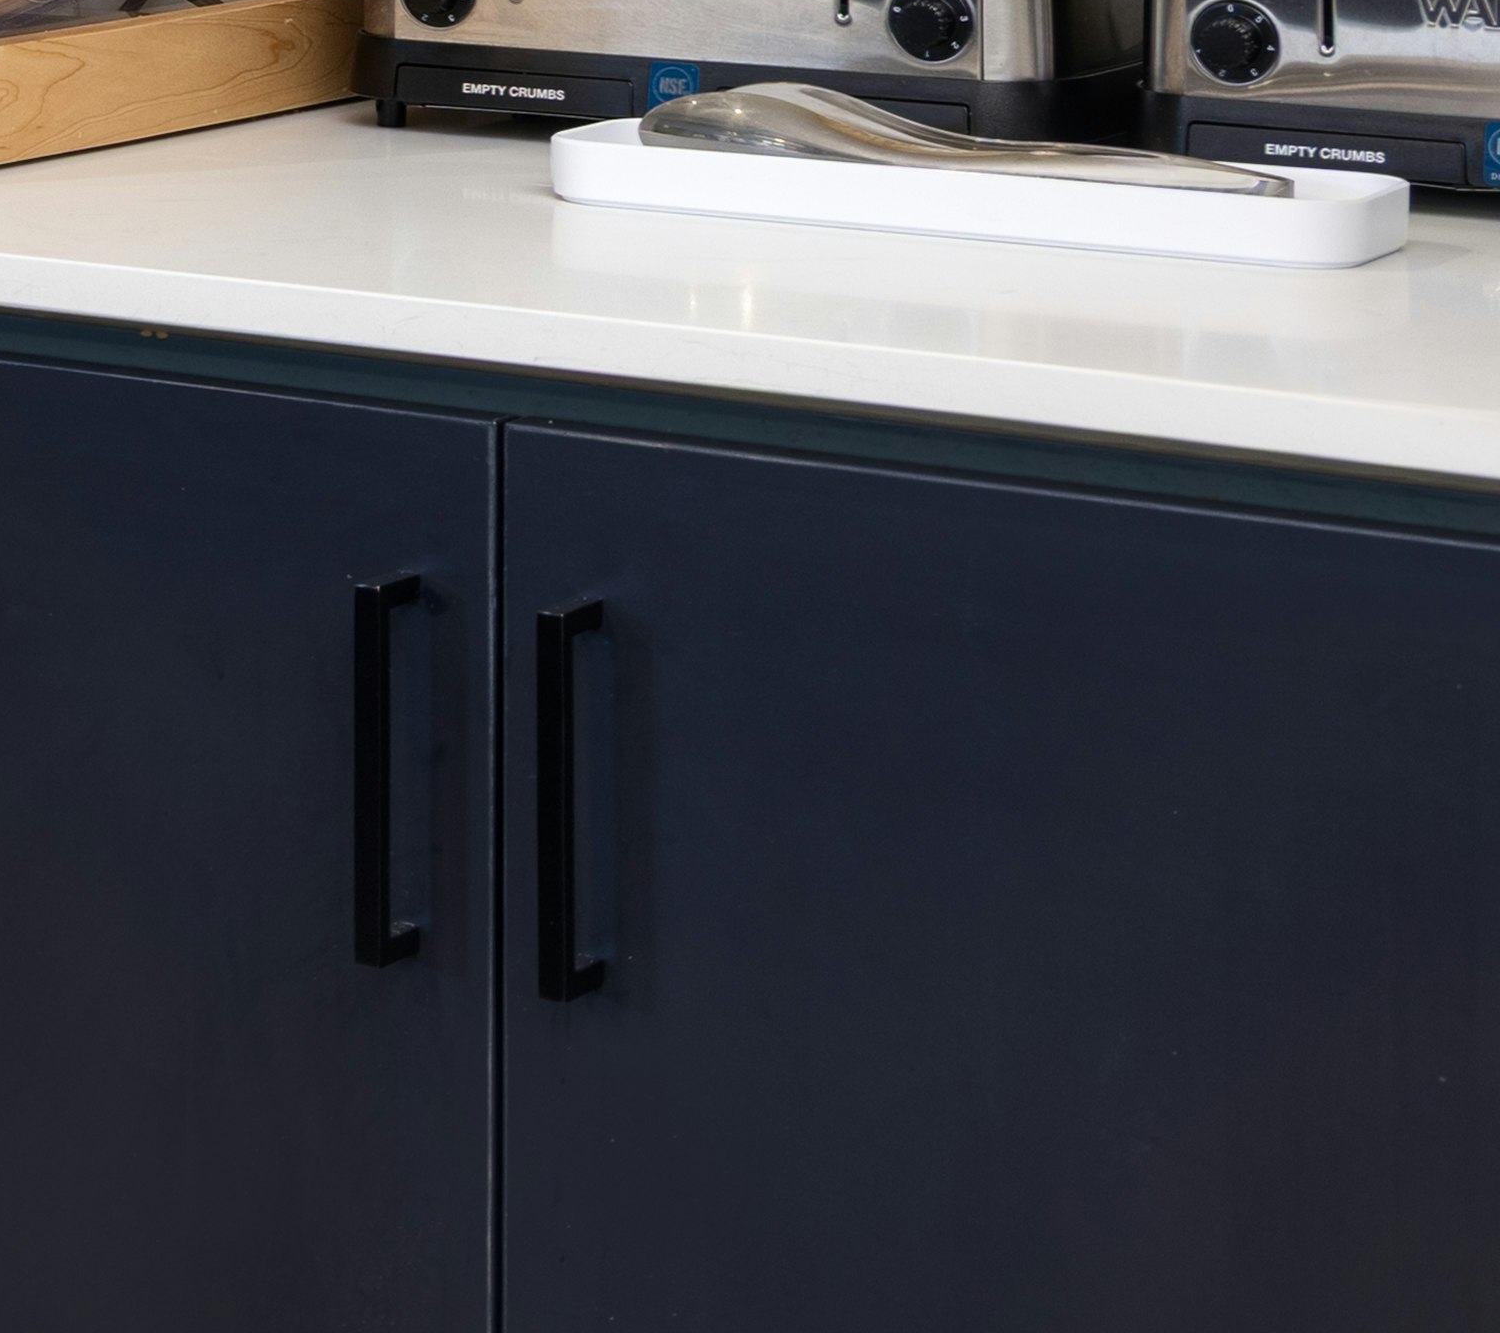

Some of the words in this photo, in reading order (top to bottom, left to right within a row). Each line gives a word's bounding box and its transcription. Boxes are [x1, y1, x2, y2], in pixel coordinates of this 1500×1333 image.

[462, 82, 507, 97] EMPTY
[509, 86, 566, 101] CRUMBS
[659, 76, 688, 95] NSF
[1264, 142, 1317, 159] EMPTY
[1319, 146, 1387, 164] CRUMBS
